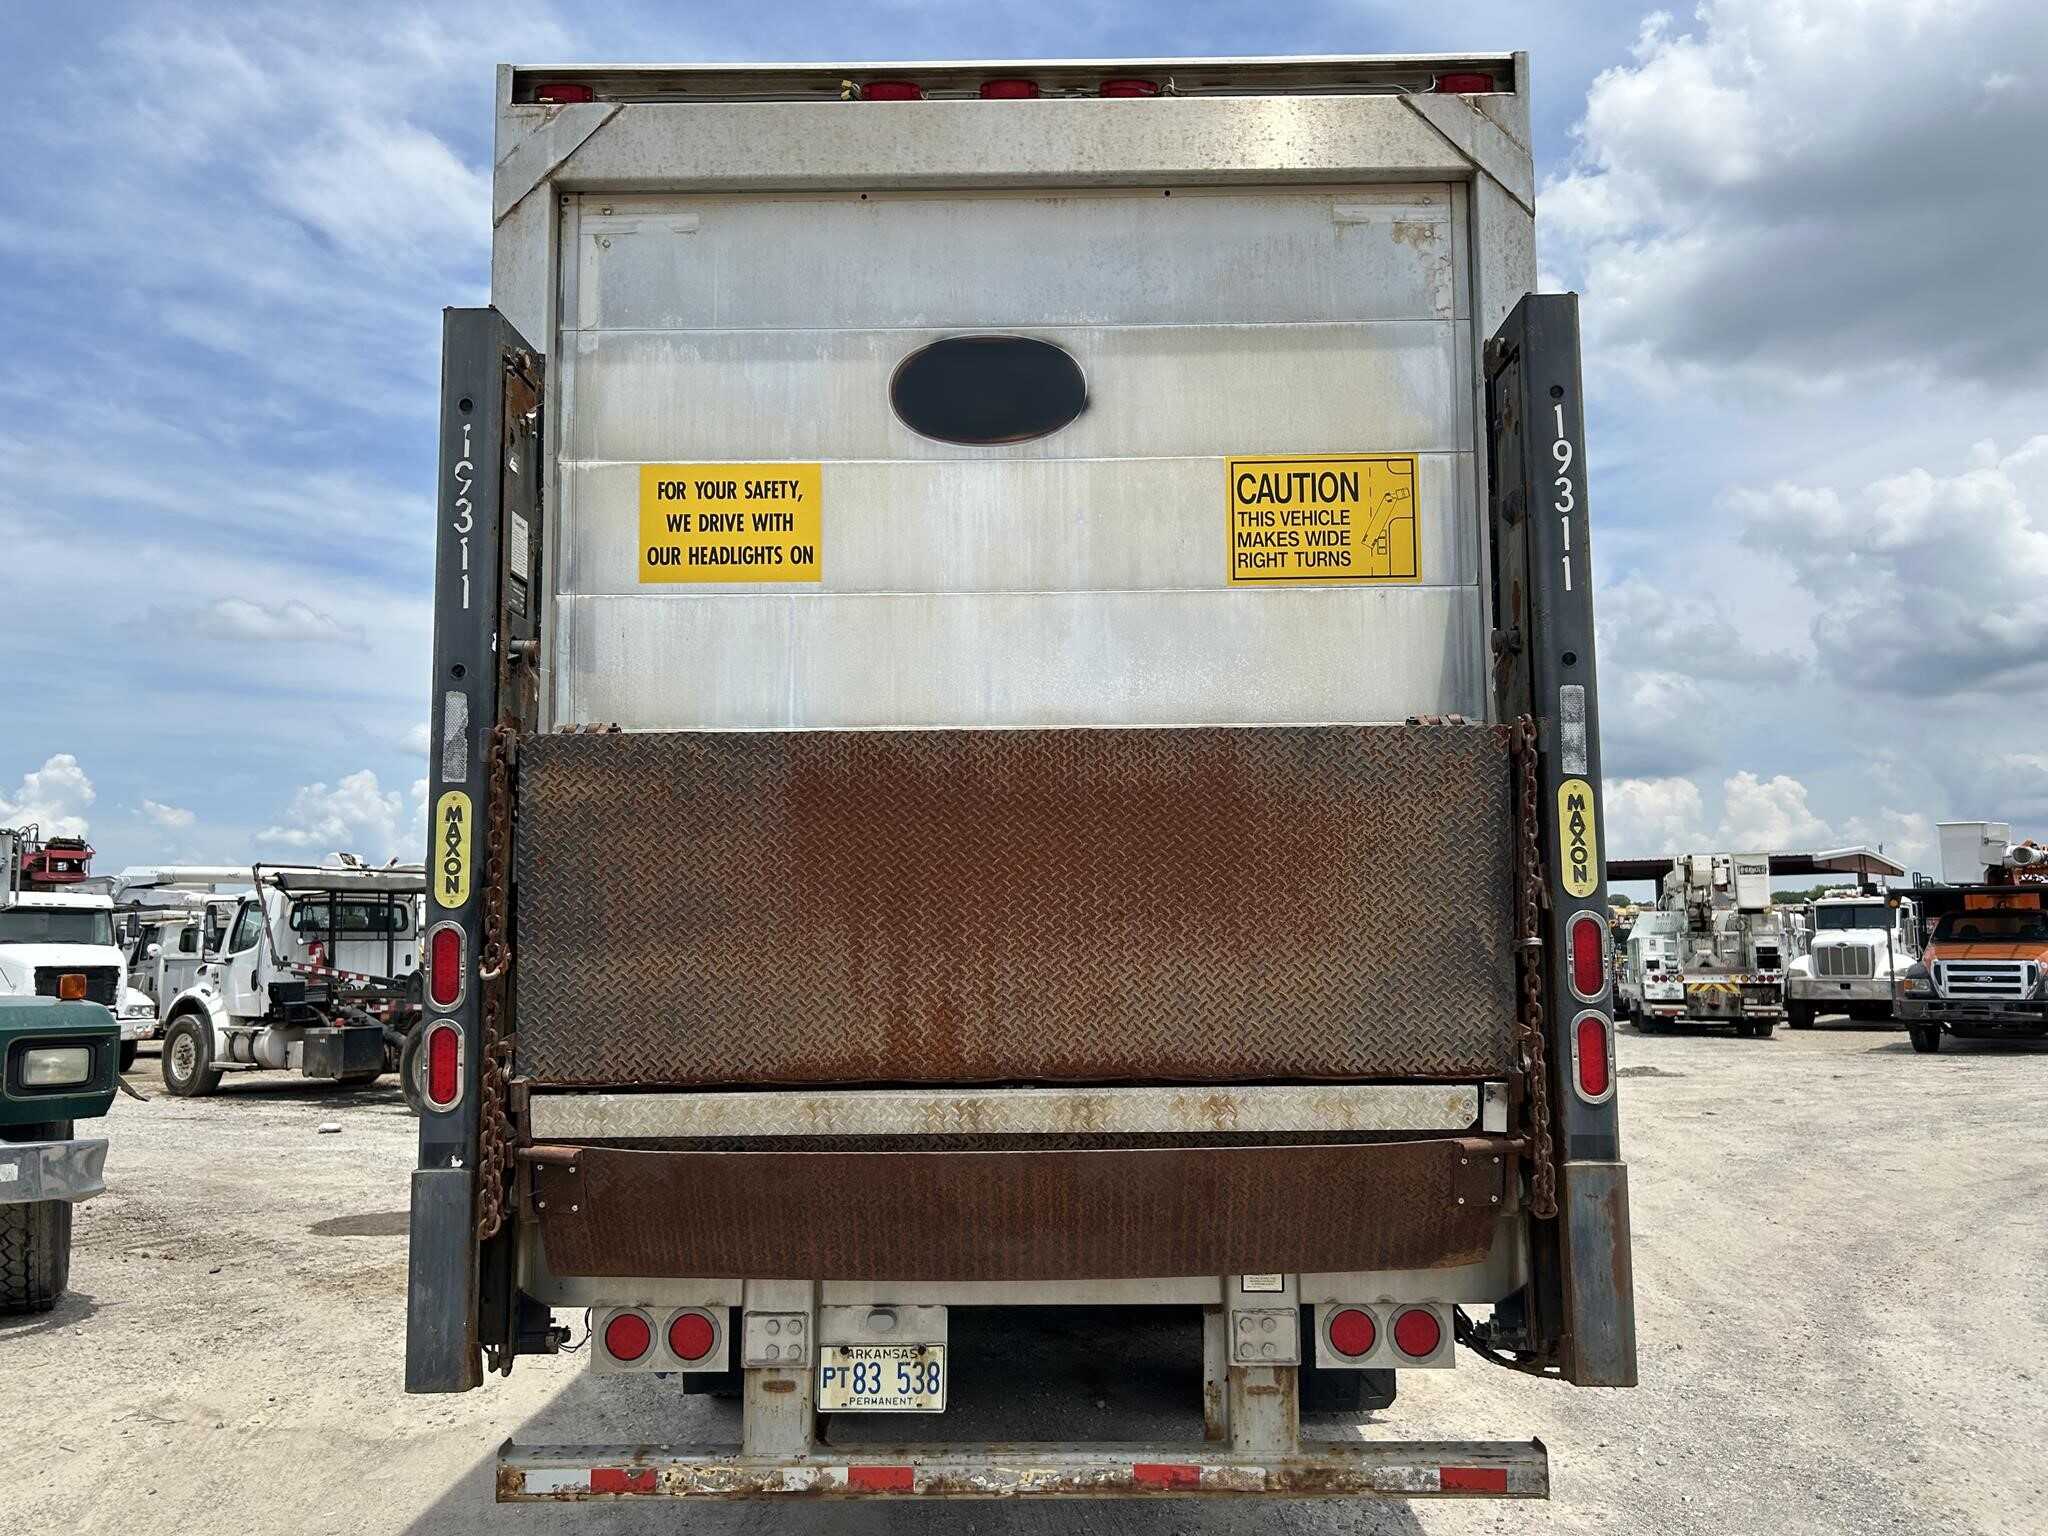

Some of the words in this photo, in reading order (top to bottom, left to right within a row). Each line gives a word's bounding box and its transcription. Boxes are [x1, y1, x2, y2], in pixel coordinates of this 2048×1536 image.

[657, 481, 686, 500] FOR
[695, 481, 737, 500] YOUR
[744, 480, 803, 502] SAFETY,
[1236, 471, 1359, 504] CAUTION
[1552, 403, 1575, 591] 19311
[666, 513, 691, 532] WE
[699, 513, 744, 532] DRIVE
[752, 513, 793, 532] WITH
[1238, 511, 1275, 527] THIS
[1280, 509, 1350, 527] VEHICLE
[1238, 531, 1299, 548] MAKES
[1305, 530, 1351, 547] WIDE
[647, 546, 681, 565] OUR
[688, 546, 783, 565] HEADLIGHTS
[790, 546, 814, 564] ON
[1238, 552, 1288, 568] RIGHT
[1294, 551, 1352, 568] TURNS
[1567, 793, 1588, 883] MAXON
[444, 806, 463, 894] MAXON
[847, 1348, 919, 1360] ARKANSAS
[897, 1361, 940, 1394] 538
[849, 1397, 913, 1406] PERMANENT
